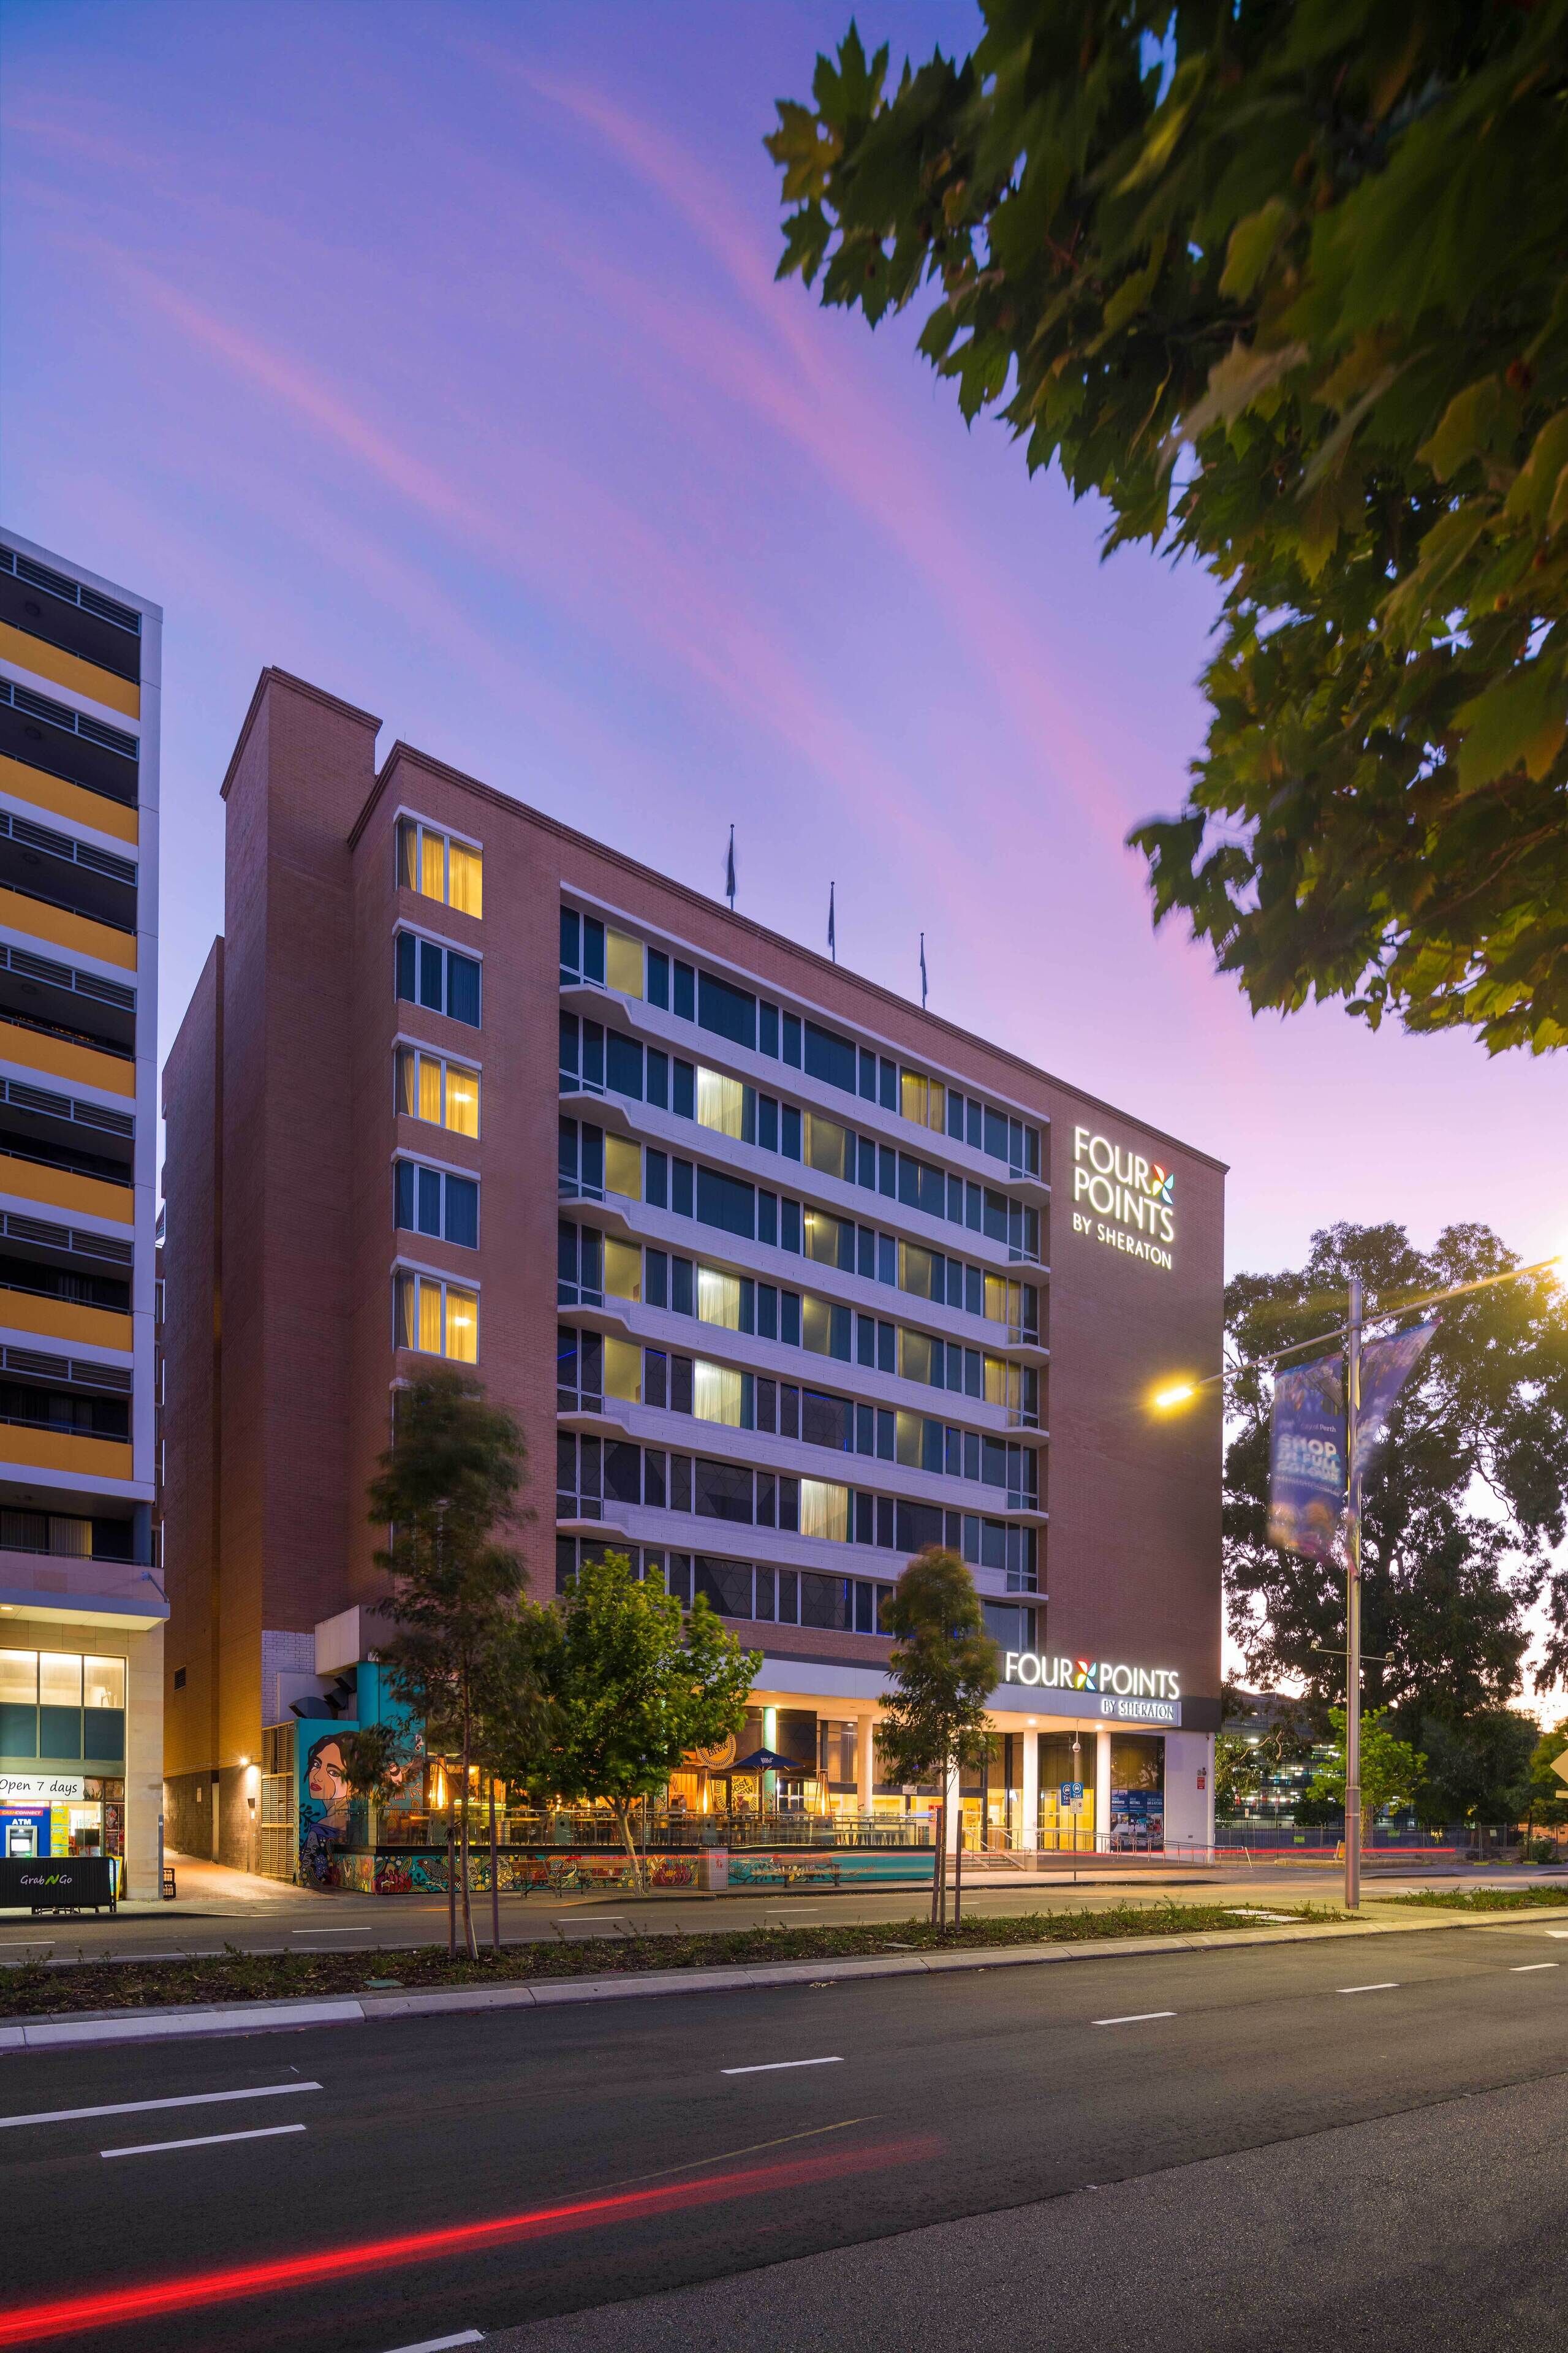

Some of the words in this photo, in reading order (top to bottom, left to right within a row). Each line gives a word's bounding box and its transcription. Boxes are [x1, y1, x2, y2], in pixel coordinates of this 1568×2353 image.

[1075, 1126, 1151, 1194] FOUR
[1075, 1166, 1174, 1242] POINTS
[1074, 1213, 1091, 1235] BY
[1097, 1223, 1172, 1270] SHERATON
[1320, 1423, 1336, 1432] Perth
[1278, 1434, 1336, 1457] SHOP
[1303, 1453, 1336, 1471] FULL
[1006, 1651, 1074, 1688] FOUR
[1100, 1663, 1180, 1700] POINTS
[1104, 1700, 1116, 1713] BY
[1121, 1702, 1174, 1718] SHERATON
[706, 1742, 729, 1757] Brew
[0, 1779, 31, 1794] Open
[37, 1781, 44, 1790] 7
[50, 1780, 77, 1797] days
[20, 1874, 45, 1885] Grab
[59, 1874, 72, 1885] Go
